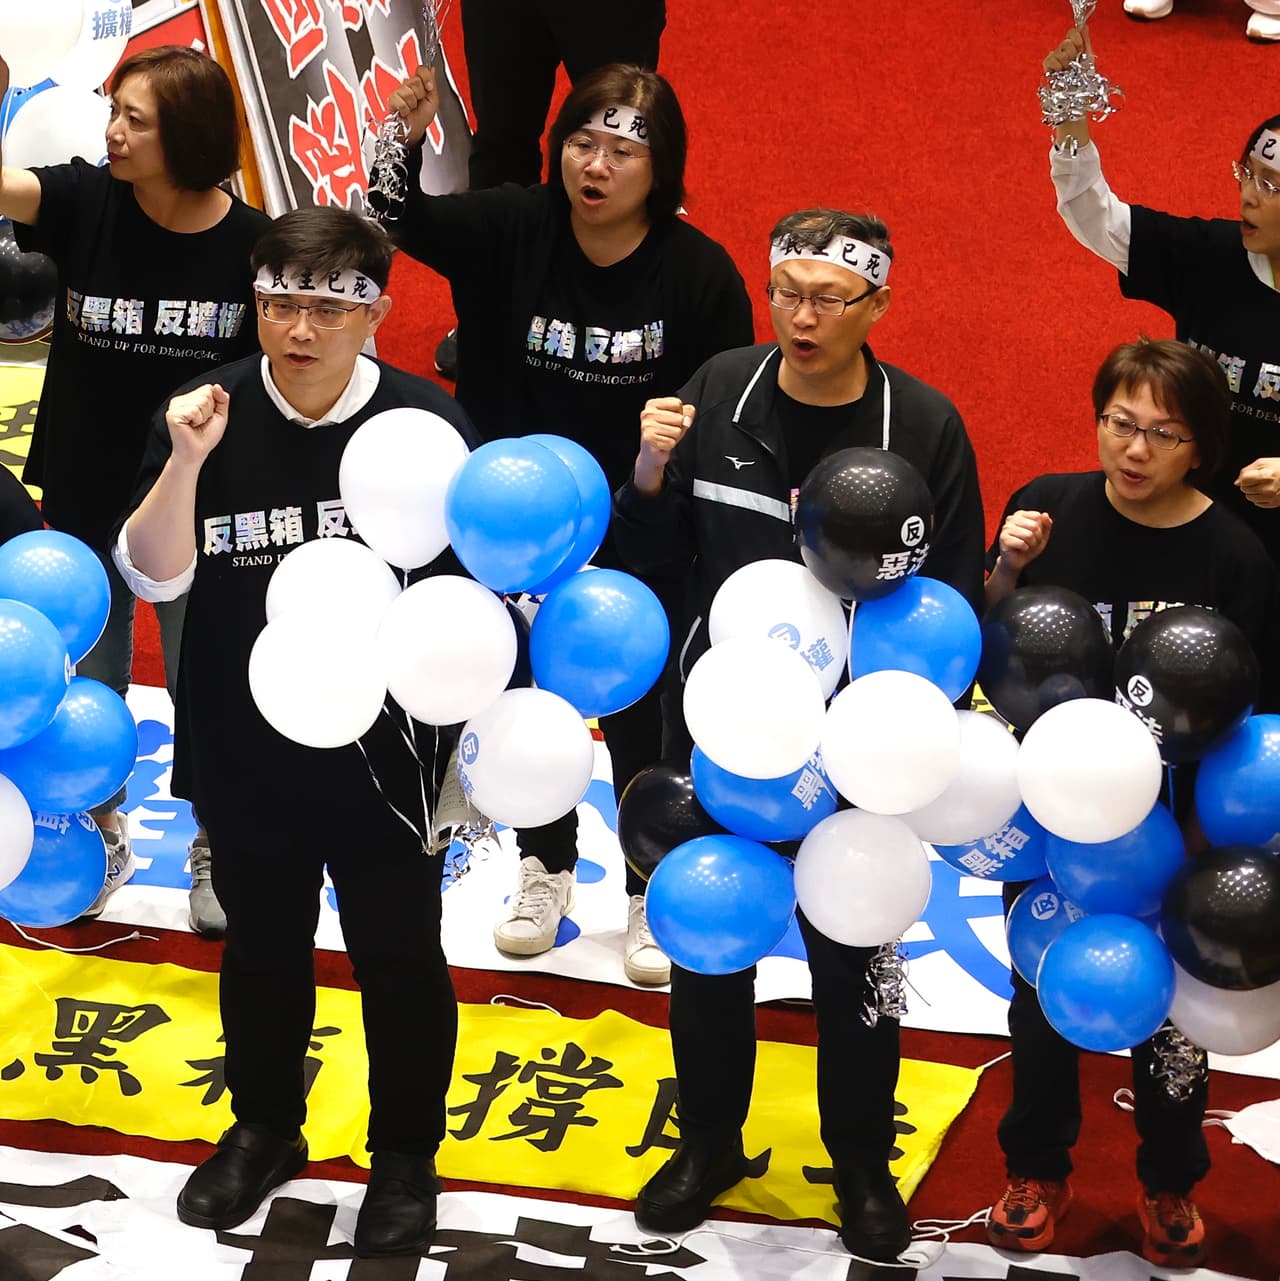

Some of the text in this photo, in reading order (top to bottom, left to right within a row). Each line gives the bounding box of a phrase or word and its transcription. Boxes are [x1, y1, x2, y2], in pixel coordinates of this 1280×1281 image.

[585, 108, 648, 140] 已死
[270, 270, 369, 299] 民主已死
[76, 333, 157, 355] STAND UP FOR
[544, 360, 562, 372] UP
[203, 505, 305, 556] 反黑箱
[231, 555, 273, 568] STAND
